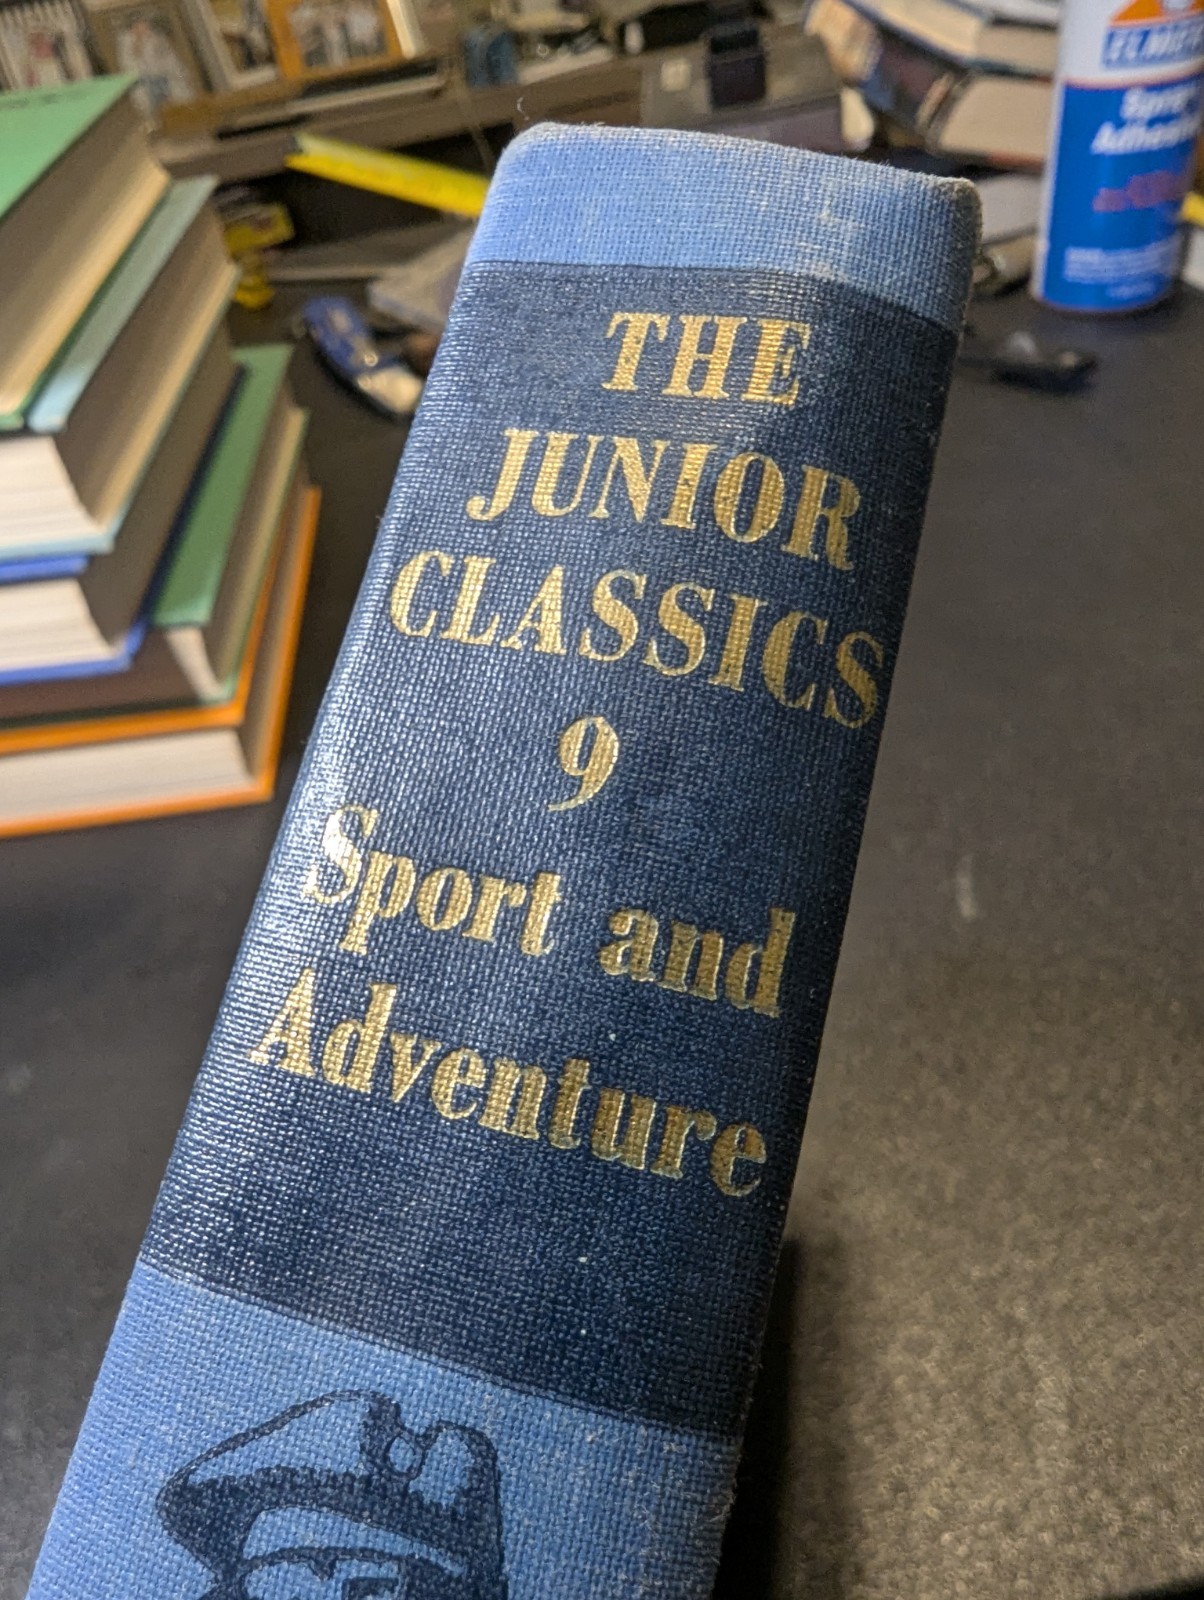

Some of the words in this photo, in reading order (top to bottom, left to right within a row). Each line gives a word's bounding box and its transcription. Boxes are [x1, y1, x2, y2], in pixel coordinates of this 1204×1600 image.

[601, 311, 811, 407] THE
[465, 428, 862, 571] JUNIOR
[388, 549, 884, 730] CLASSICS
[547, 715, 621, 812] 9
[302, 804, 562, 957] Sport
[599, 906, 796, 1020] and
[249, 966, 767, 1198] Adventure
